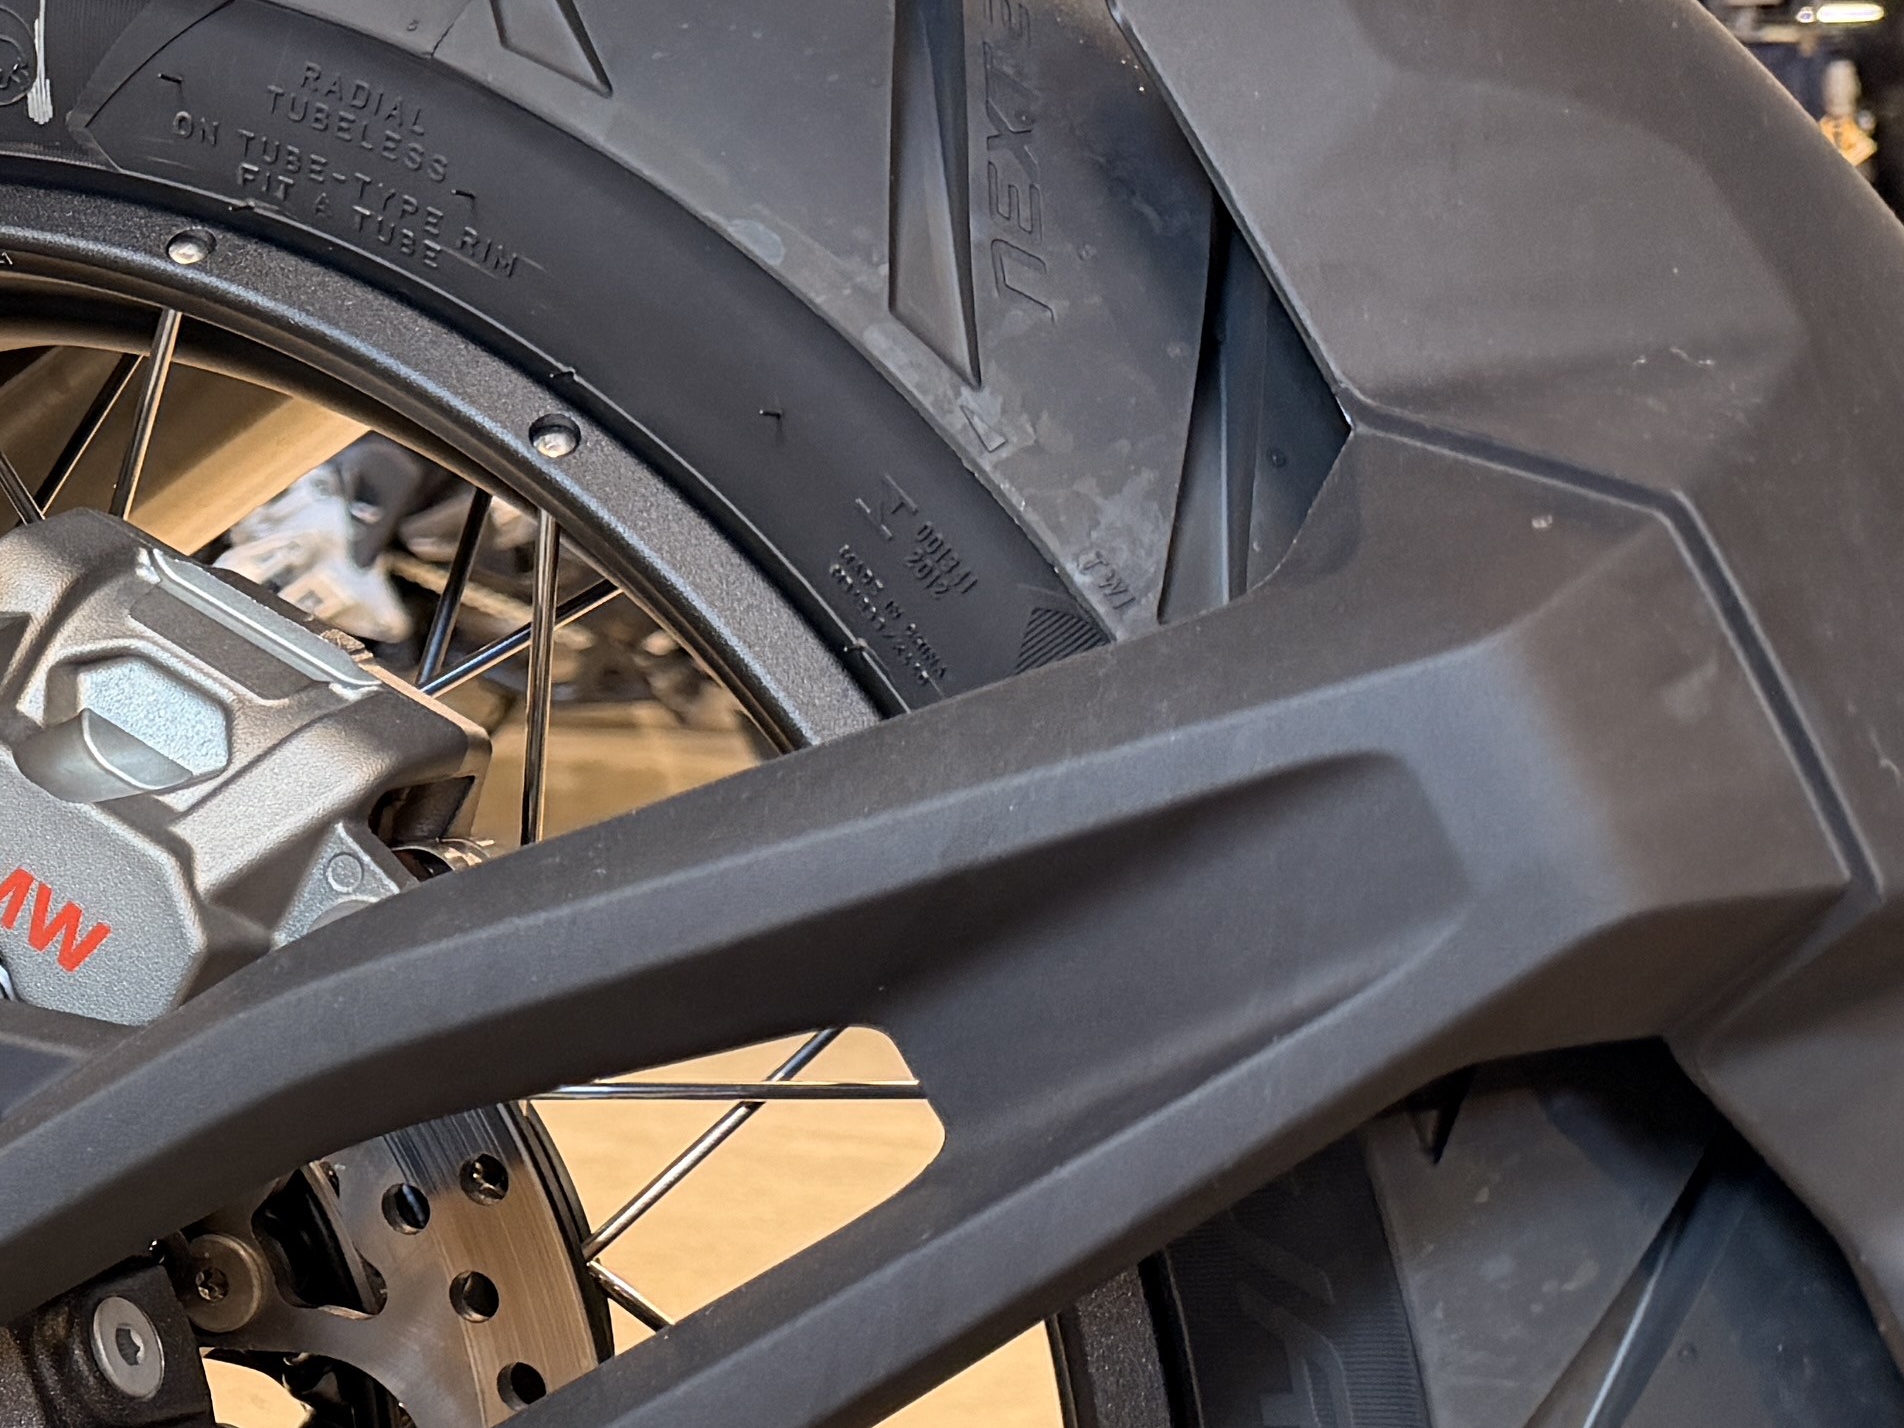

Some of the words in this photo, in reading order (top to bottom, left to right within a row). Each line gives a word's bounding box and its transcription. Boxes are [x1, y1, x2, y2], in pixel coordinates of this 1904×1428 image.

[266, 83, 449, 182] TUBELESS
[299, 59, 425, 136] RADIAL
[172, 109, 220, 146] ON
[237, 128, 444, 236] TUBE-TYPE
[459, 224, 519, 279] RIM
[237, 161, 295, 201] FIT
[314, 191, 330, 218] A
[352, 203, 442, 268] TUBE
